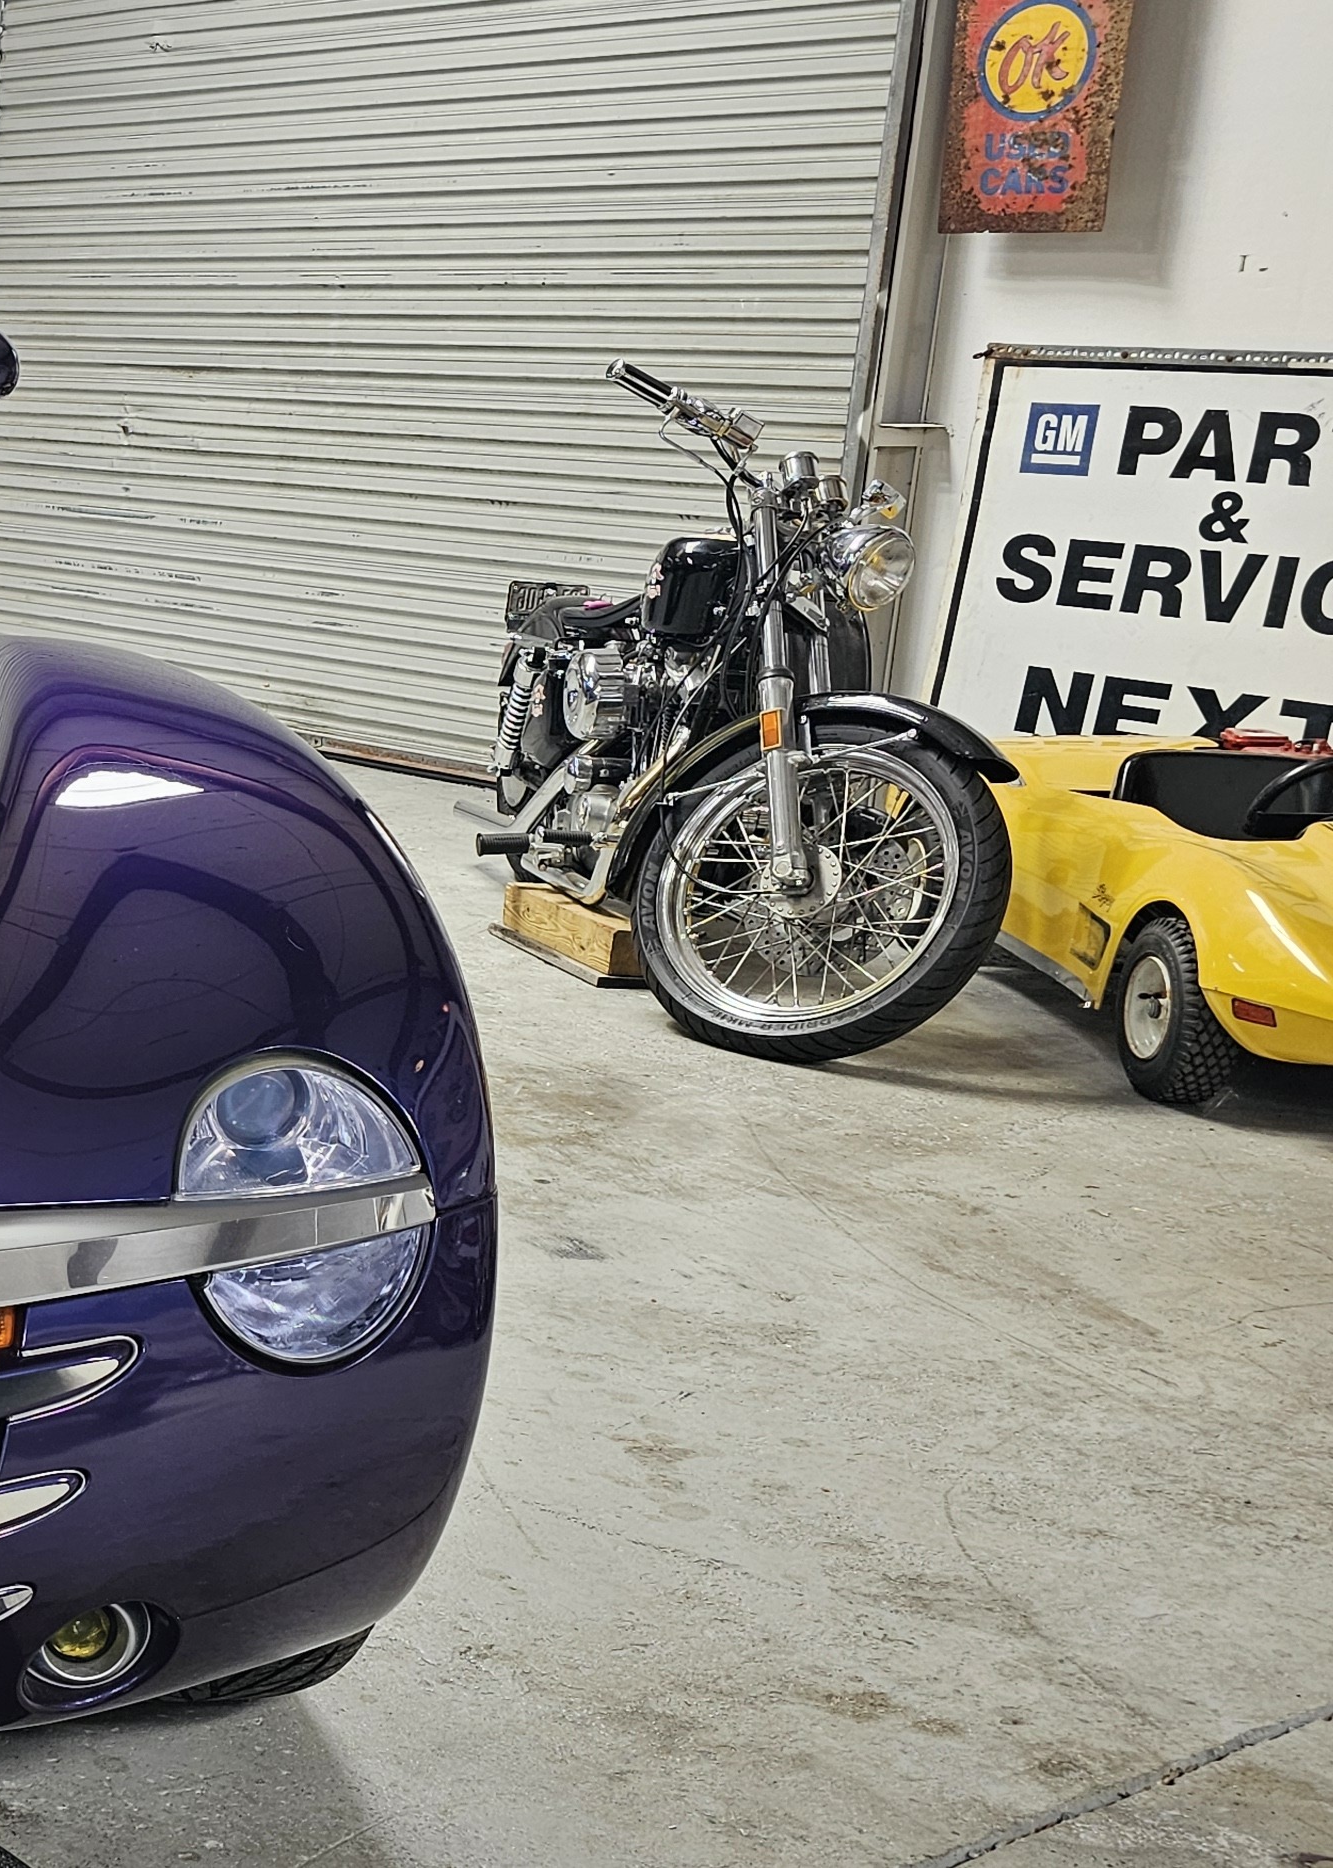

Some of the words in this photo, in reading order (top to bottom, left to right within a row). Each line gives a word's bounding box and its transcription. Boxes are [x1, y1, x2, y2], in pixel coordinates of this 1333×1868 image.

[997, 20, 1071, 96] OK
[979, 166, 1070, 197] CARS
[984, 131, 1071, 162] USED
[1034, 412, 1089, 453] GM
[1117, 405, 1333, 487] PAR
[1198, 490, 1251, 544] &
[1013, 665, 1333, 746] NEXT
[642, 863, 659, 929] AVON
[956, 828, 974, 902] AVON
